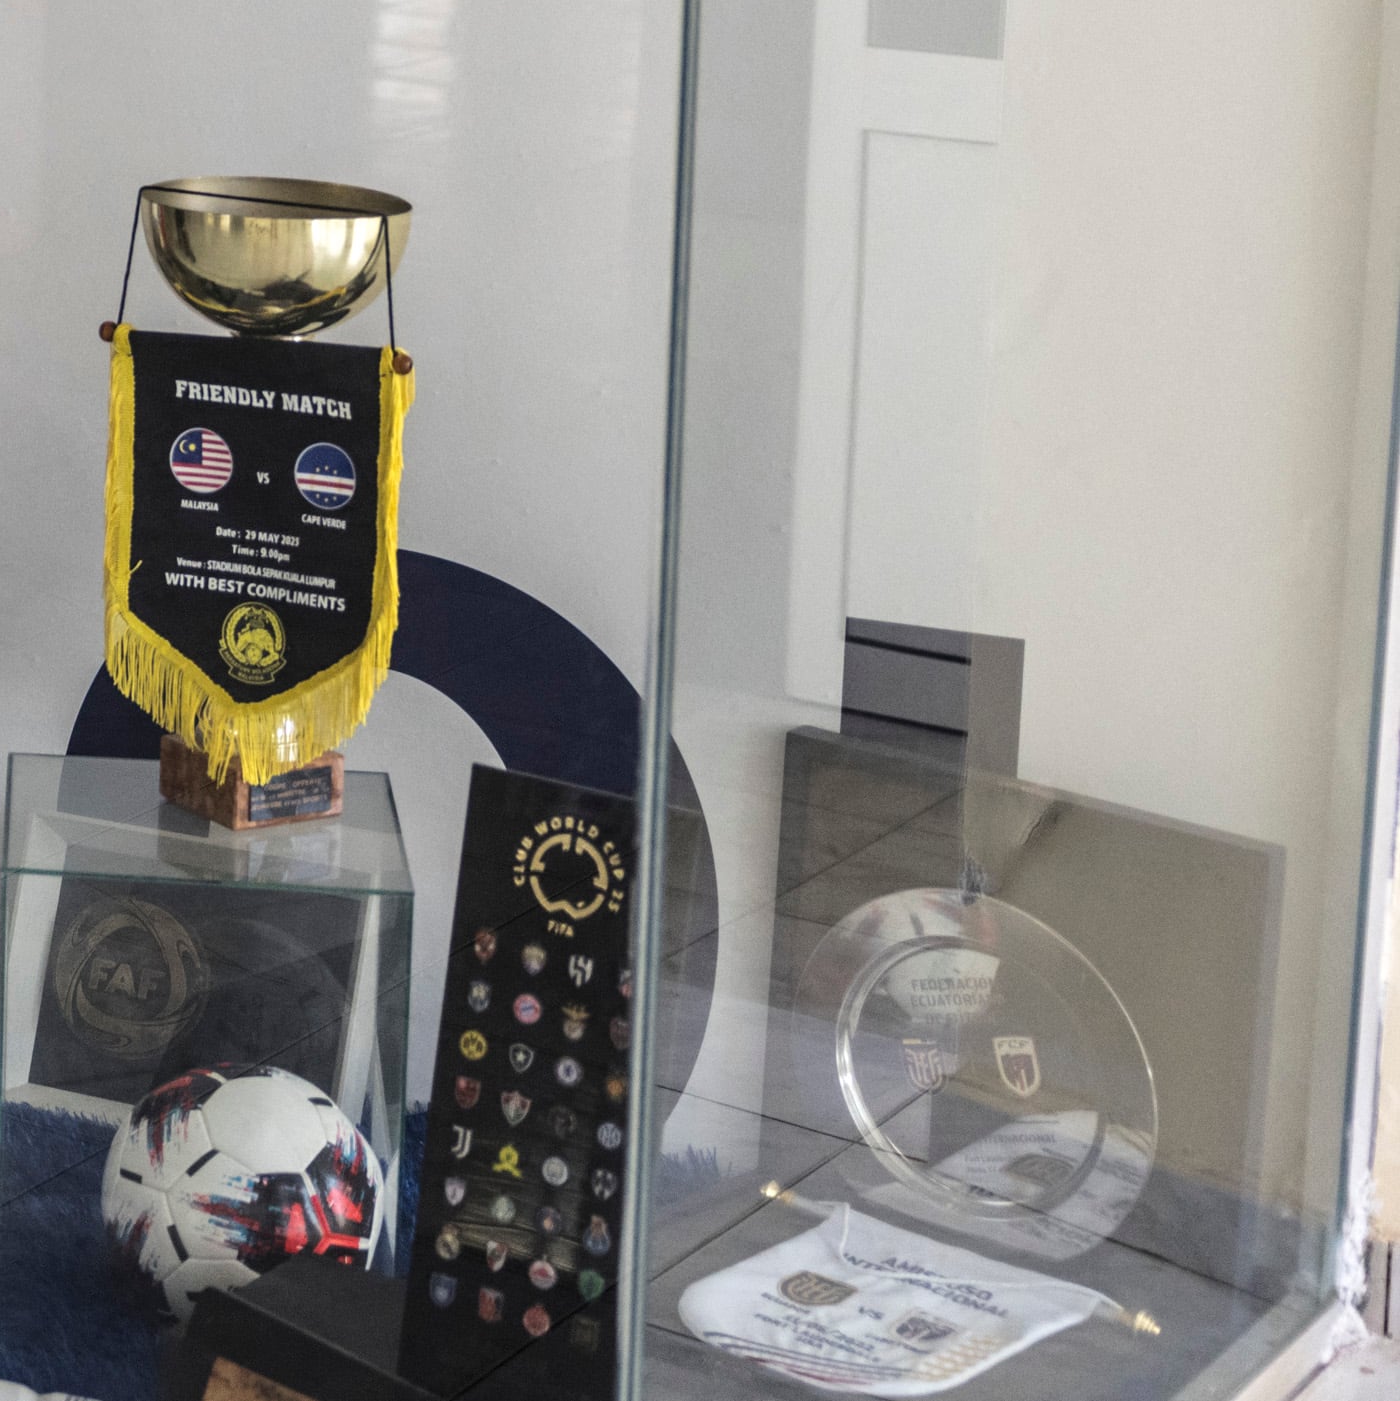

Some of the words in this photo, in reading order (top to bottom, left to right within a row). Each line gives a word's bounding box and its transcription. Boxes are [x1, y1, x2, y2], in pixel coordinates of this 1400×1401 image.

[175, 379, 275, 408] FRIENDLY
[280, 392, 352, 420] MATCH
[256, 471, 270, 484] VS
[180, 498, 219, 511] MALAYSIA
[301, 513, 321, 525] CAPE
[321, 516, 346, 530] VERDE
[244, 529, 256, 540] 29
[257, 531, 280, 544] MAY
[164, 571, 205, 589] WITH
[207, 576, 245, 594] BEST
[246, 582, 345, 612] COMPLIMENTS
[513, 836, 534, 886] CLUB
[534, 816, 599, 840] WORLD
[603, 841, 625, 880] CUP
[88, 959, 166, 1000] FAF
